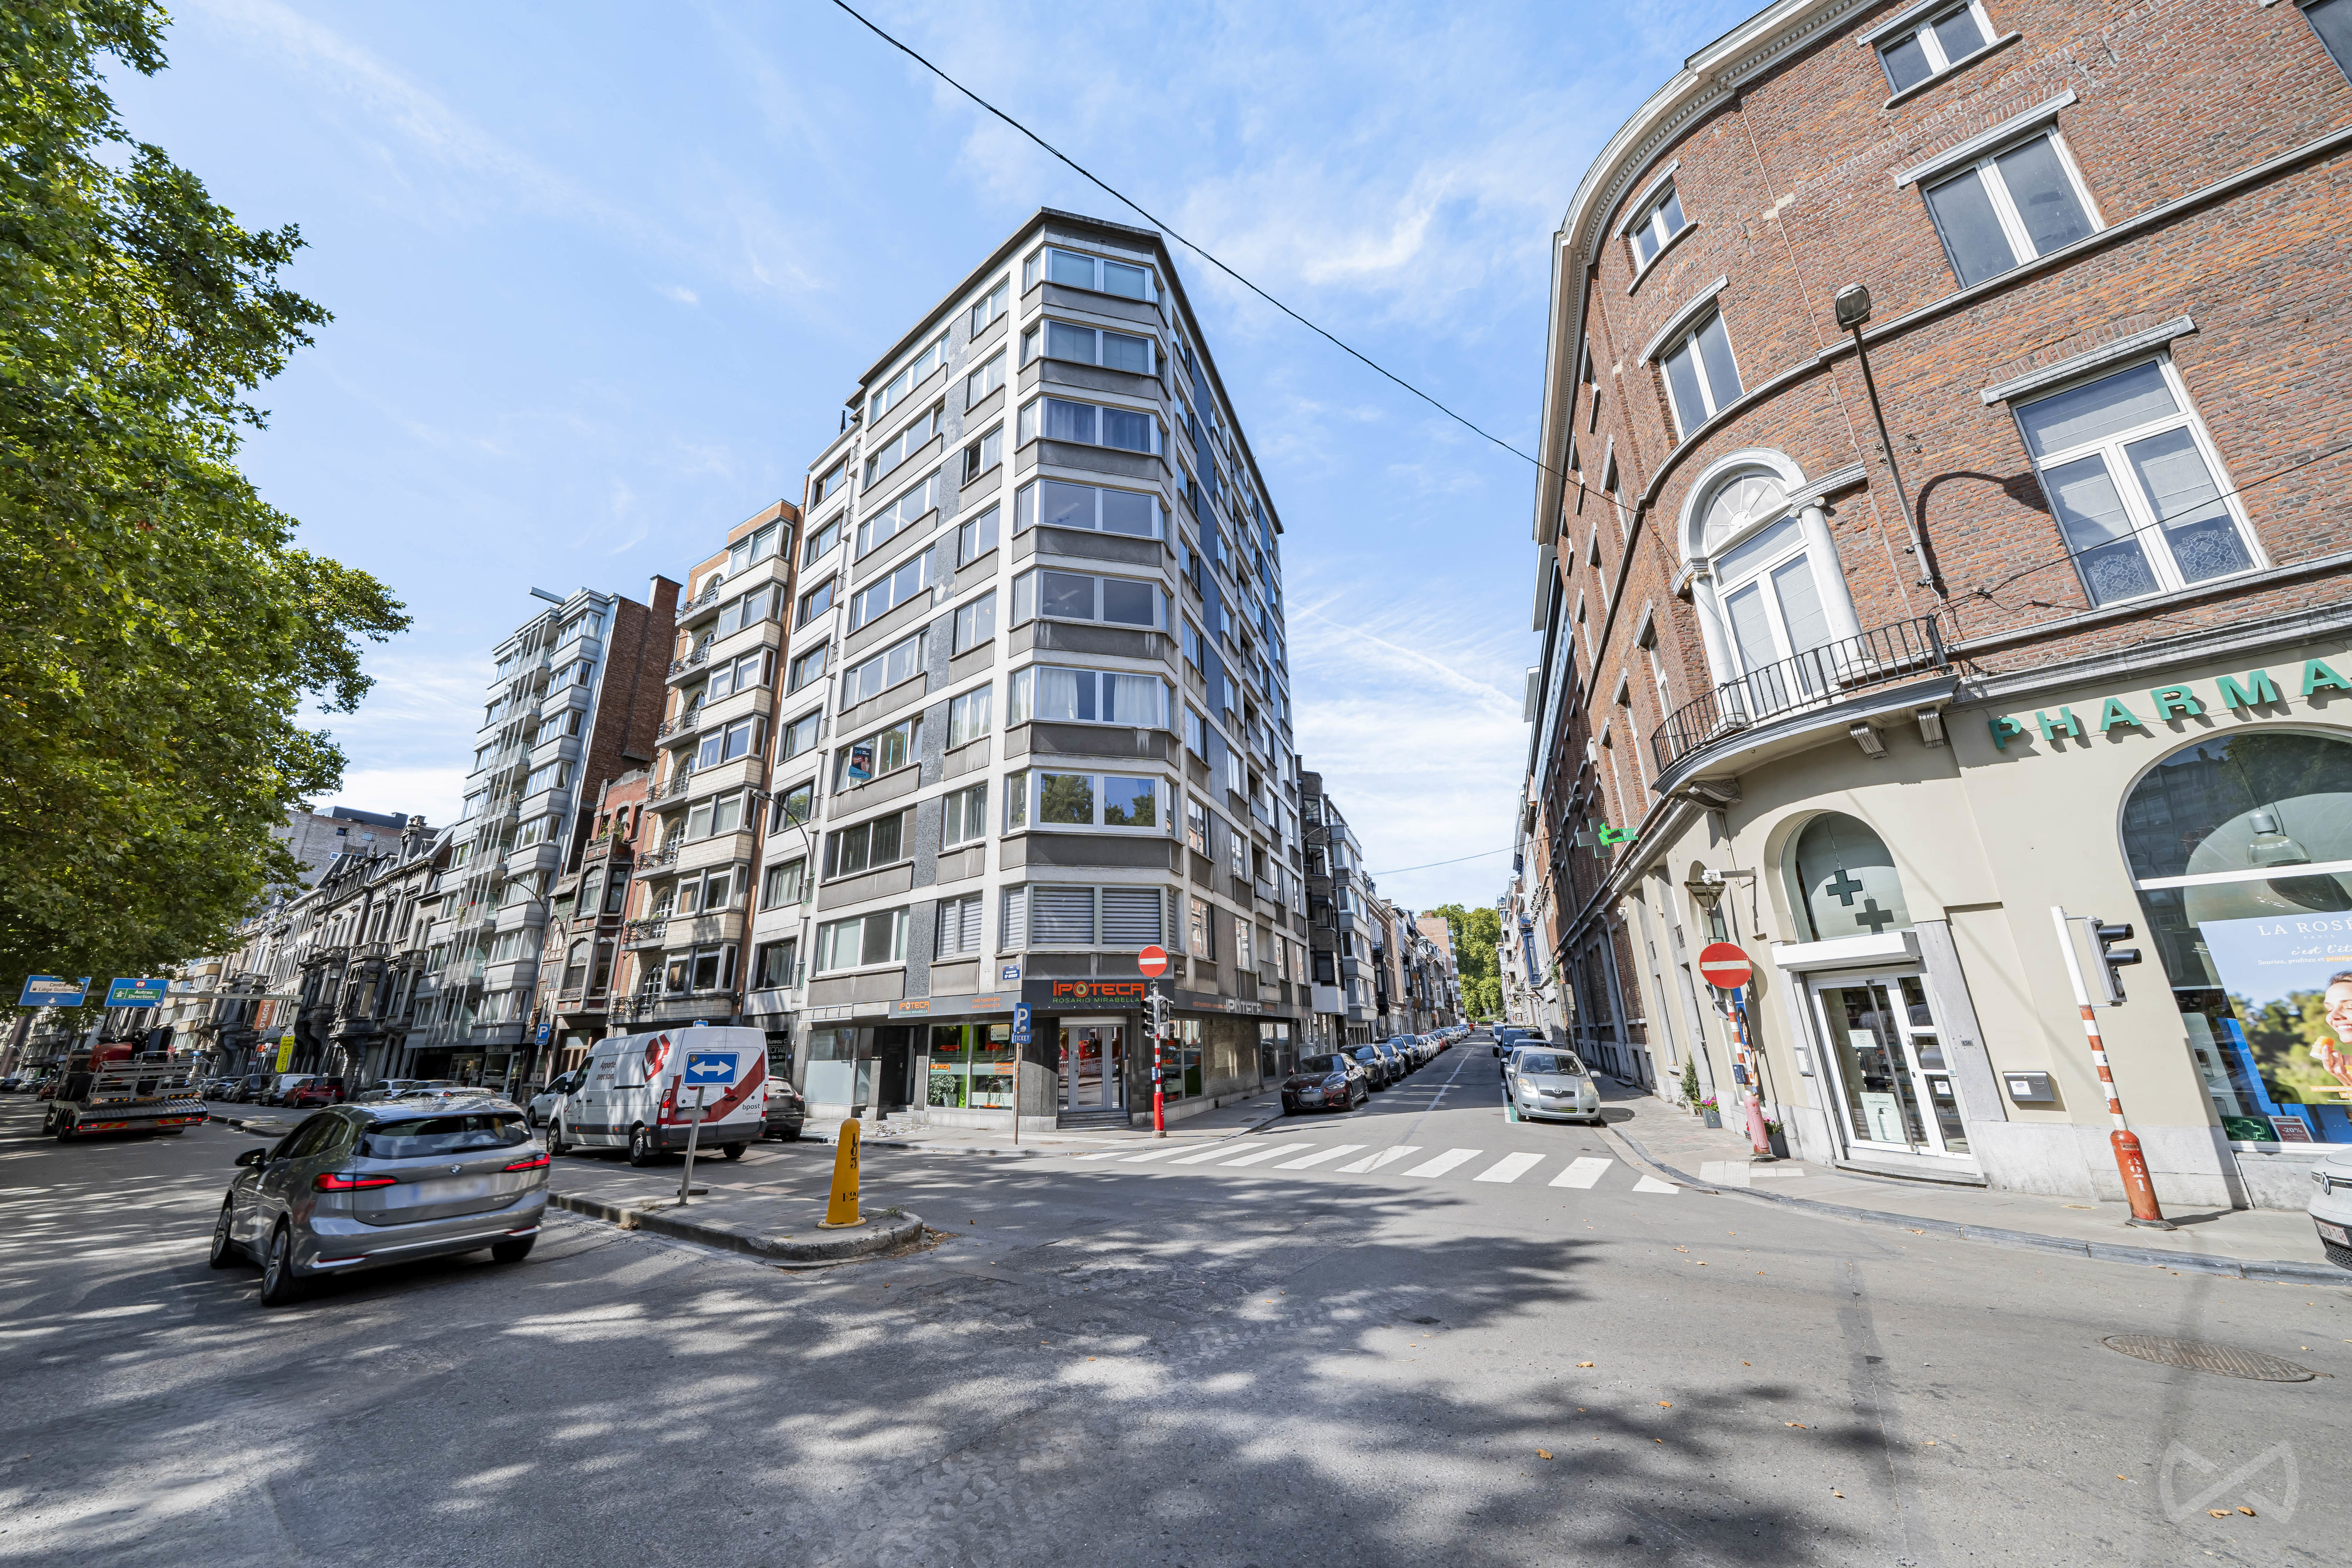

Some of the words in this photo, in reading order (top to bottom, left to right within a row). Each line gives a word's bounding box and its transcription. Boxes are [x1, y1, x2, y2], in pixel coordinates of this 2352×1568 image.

[1988, 658, 2352, 749] PHARMA
[2257, 924, 2289, 936] LA
[2291, 945, 2322, 955] c'est
[259, 1004, 271, 1028] O'TACOS
[1017, 1008, 1028, 1027] P
[538, 1026, 548, 1037] P
[599, 1060, 617, 1071] Apporté
[605, 1071, 615, 1080] soin.
